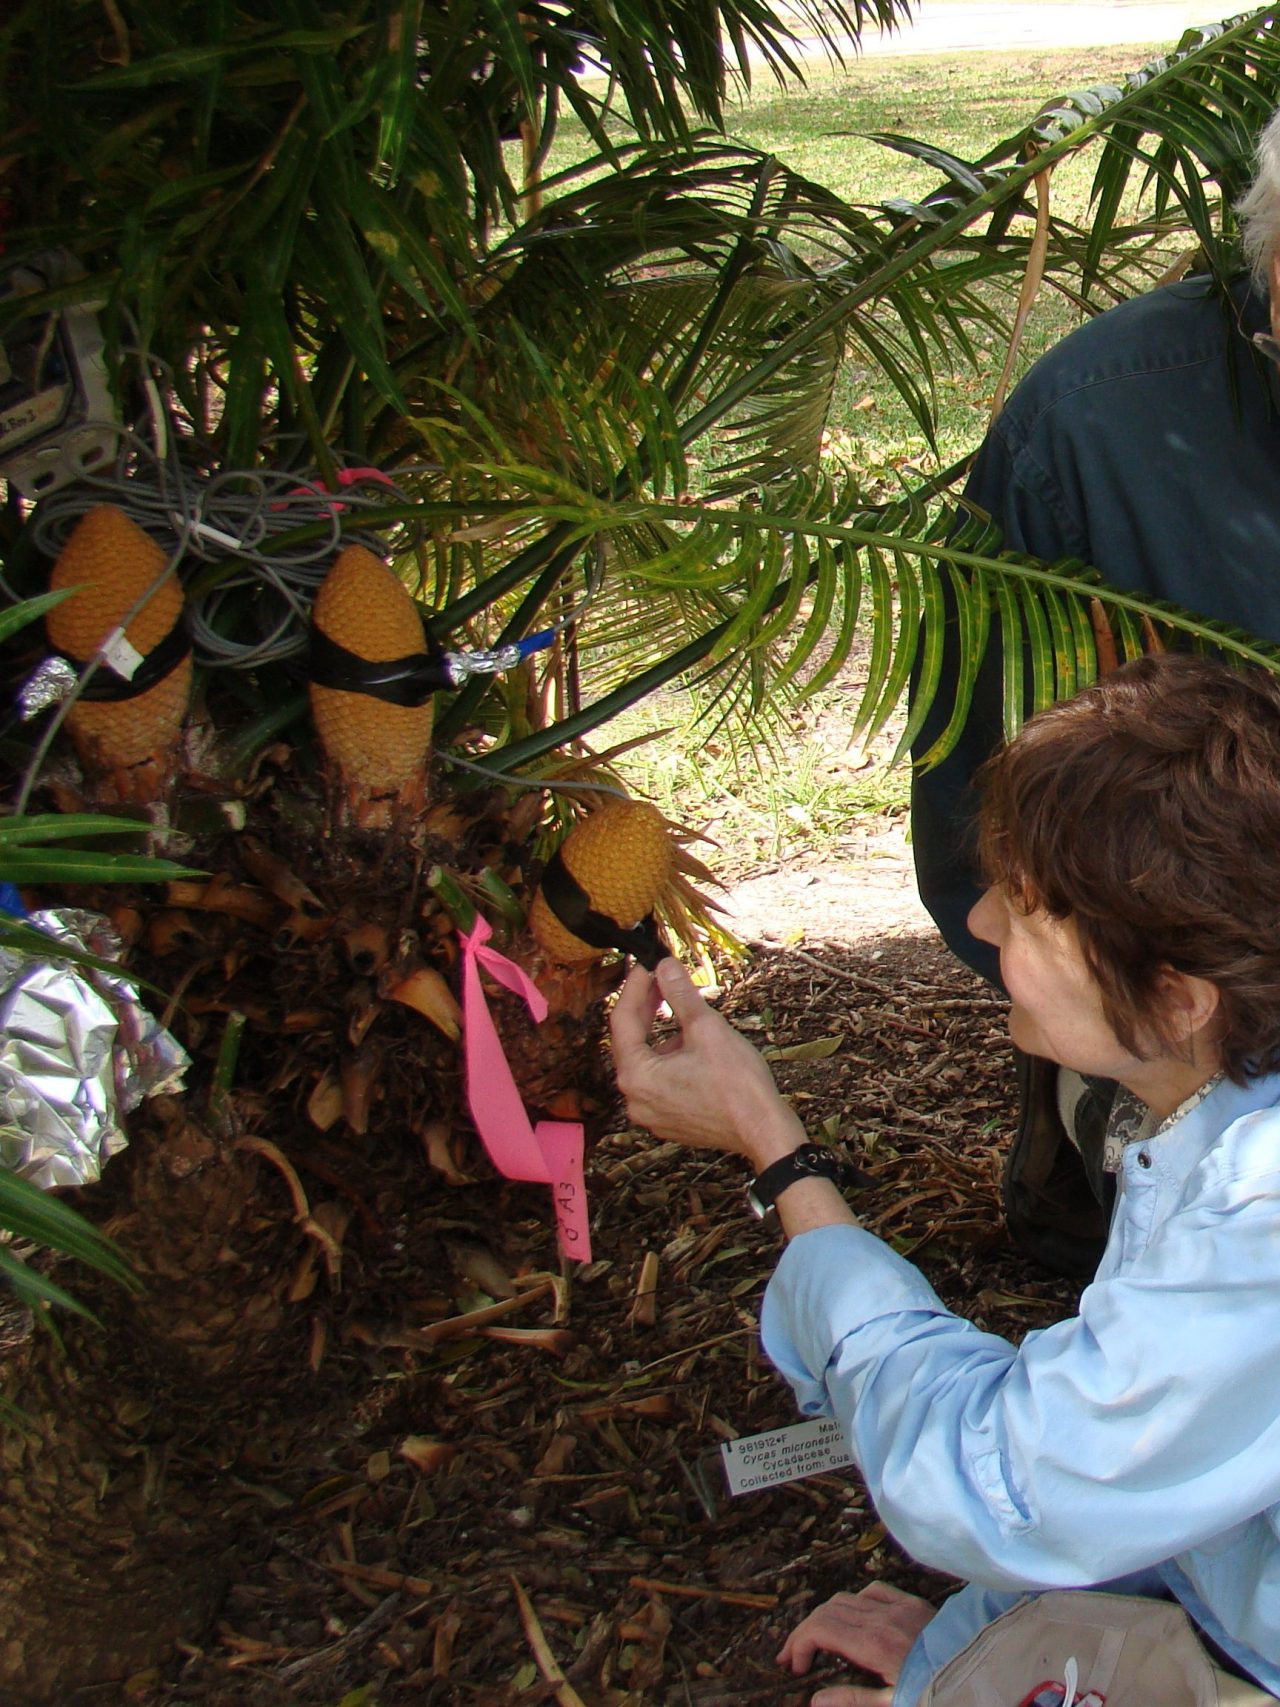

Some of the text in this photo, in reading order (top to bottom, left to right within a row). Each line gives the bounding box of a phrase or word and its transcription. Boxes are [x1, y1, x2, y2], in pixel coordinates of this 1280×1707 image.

[743, 1433, 844, 1465] Cycas micronesic
[763, 1448, 831, 1471] Cycadaceae
[740, 1467, 793, 1488] Collected
[797, 1460, 825, 1474] from:
